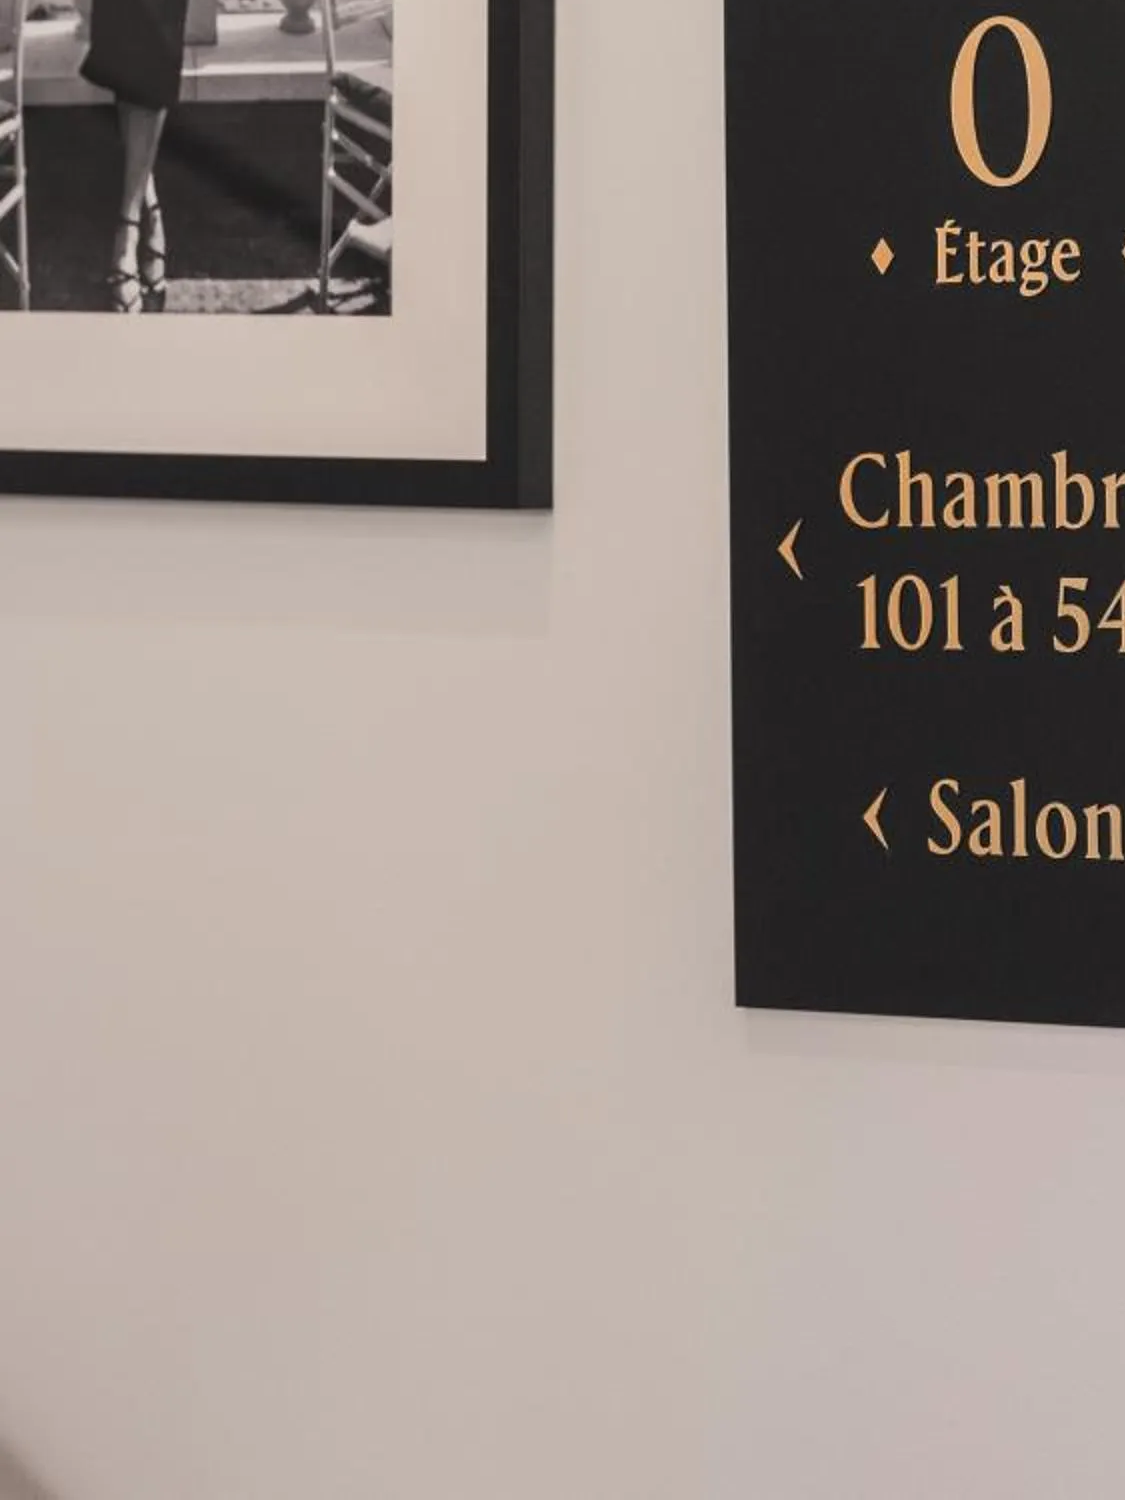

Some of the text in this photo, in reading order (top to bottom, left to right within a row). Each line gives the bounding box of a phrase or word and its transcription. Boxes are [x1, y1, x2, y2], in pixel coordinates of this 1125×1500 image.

[949, 14, 1054, 189] 0
[933, 219, 1082, 299] Étage
[858, 574, 962, 652] 101
[989, 584, 1026, 653] à
[926, 777, 1125, 862] Salon
